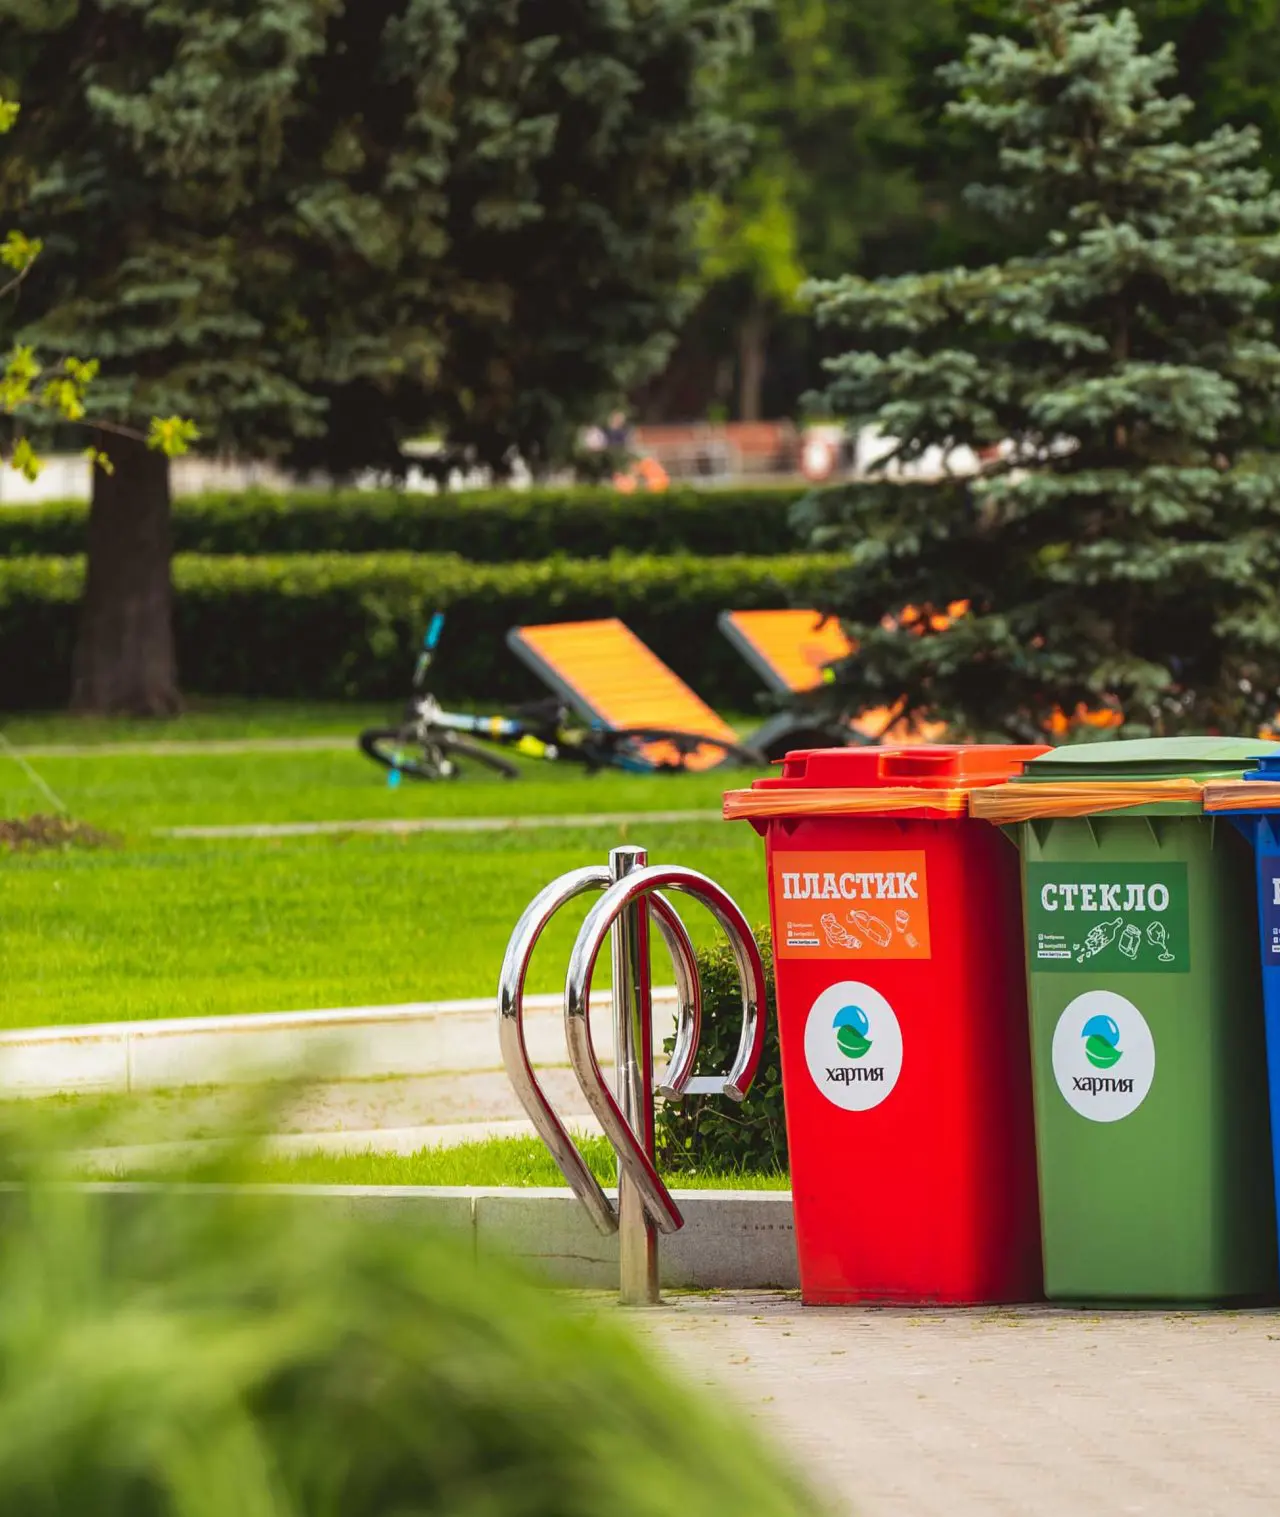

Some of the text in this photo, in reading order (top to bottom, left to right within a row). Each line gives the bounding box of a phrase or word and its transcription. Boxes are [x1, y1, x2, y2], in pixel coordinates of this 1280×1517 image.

[781, 872, 919, 900] ПЛАСТИК
[1041, 883, 1170, 912] СТЕКЛО
[825, 1067, 884, 1086] хартия
[1072, 1076, 1135, 1096] хартия
